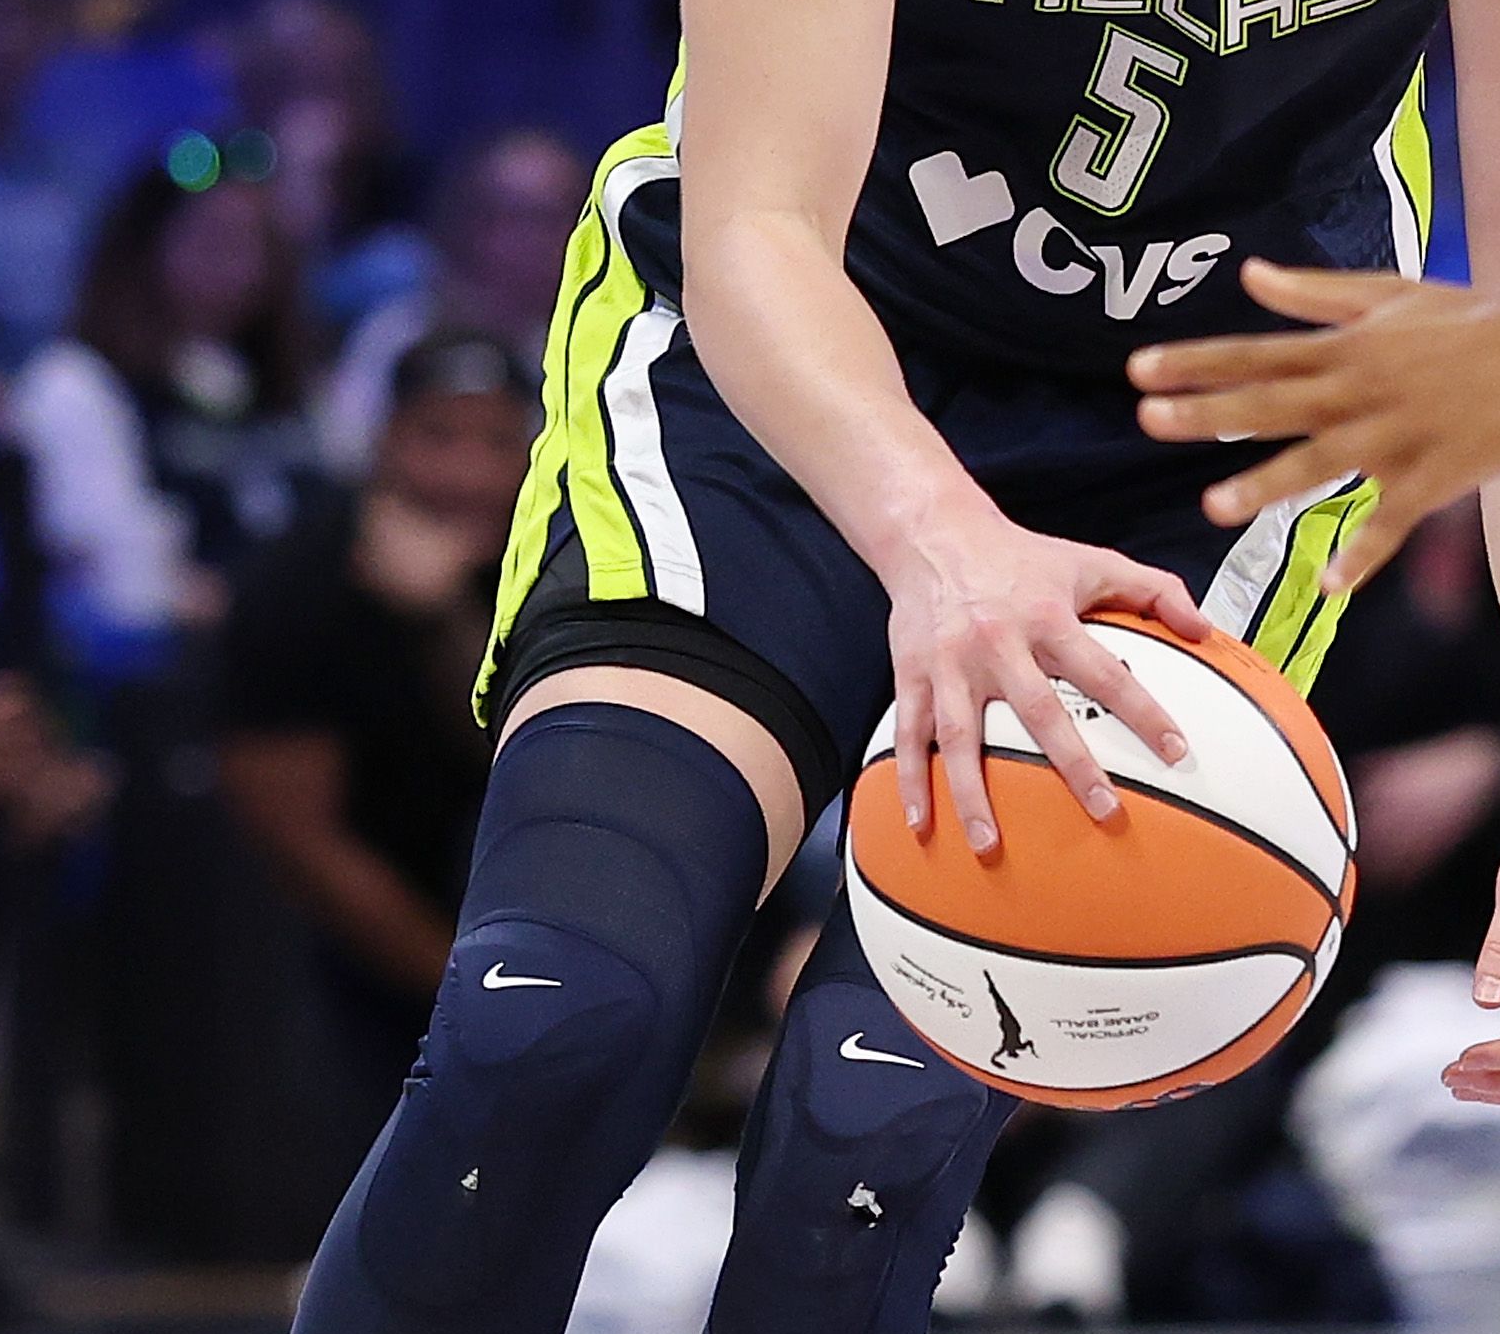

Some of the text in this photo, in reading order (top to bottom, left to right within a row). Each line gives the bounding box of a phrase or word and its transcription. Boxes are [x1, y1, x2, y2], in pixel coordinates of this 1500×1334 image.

[1049, 22, 1189, 217] 5
[1012, 206, 1231, 320] CVS
[1050, 1019, 1100, 1028] BALL
[1104, 1011, 1160, 1028] GAME
[1064, 1026, 1149, 1039] OFFICIAL
